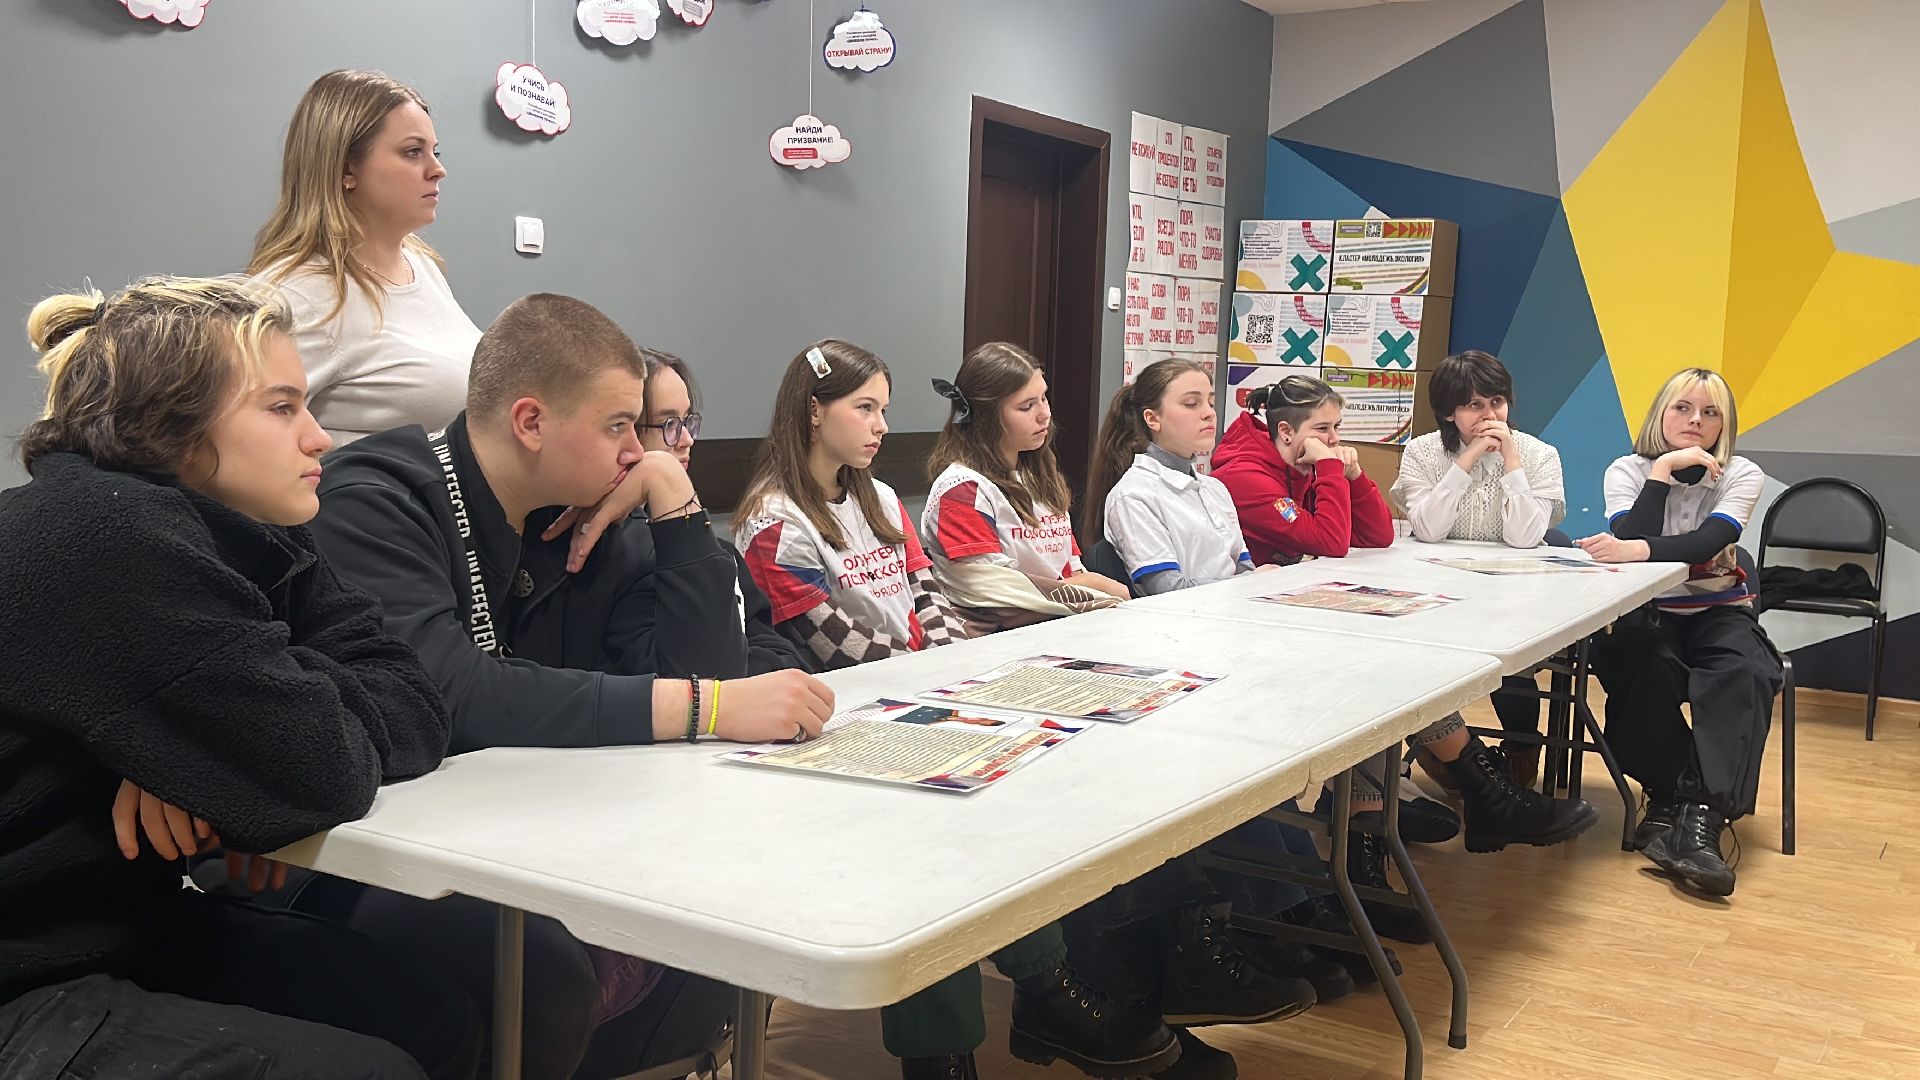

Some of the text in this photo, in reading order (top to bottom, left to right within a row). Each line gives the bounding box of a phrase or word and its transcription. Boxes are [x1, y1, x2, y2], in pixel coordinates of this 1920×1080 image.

[827, 47, 891, 57] ОТКРЫВАЙ СТРАНУ!
[510, 84, 516, 92] И
[522, 75, 545, 91] УЧИСЬ
[795, 126, 823, 134] НАЙДИ
[1183, 156, 1197, 172] ЕСЛИ
[1183, 176, 1197, 193] НЕ ТЫ
[1180, 209, 1194, 226] ПОРА
[1157, 218, 1175, 237] ВСЕГДА
[1179, 231, 1197, 249] ЧТО-ТО
[1156, 240, 1175, 257] РЯДОМ
[1179, 253, 1198, 270] МЕНЯТЬ
[1338, 254, 1361, 262] КЛАСТЕР
[1177, 285, 1191, 302] ПОРА
[1176, 307, 1194, 324] ЧТО-ТО
[1149, 328, 1172, 344] ЗНАЧЕНИЕ
[1175, 329, 1195, 345] МЕНЯТЬ
